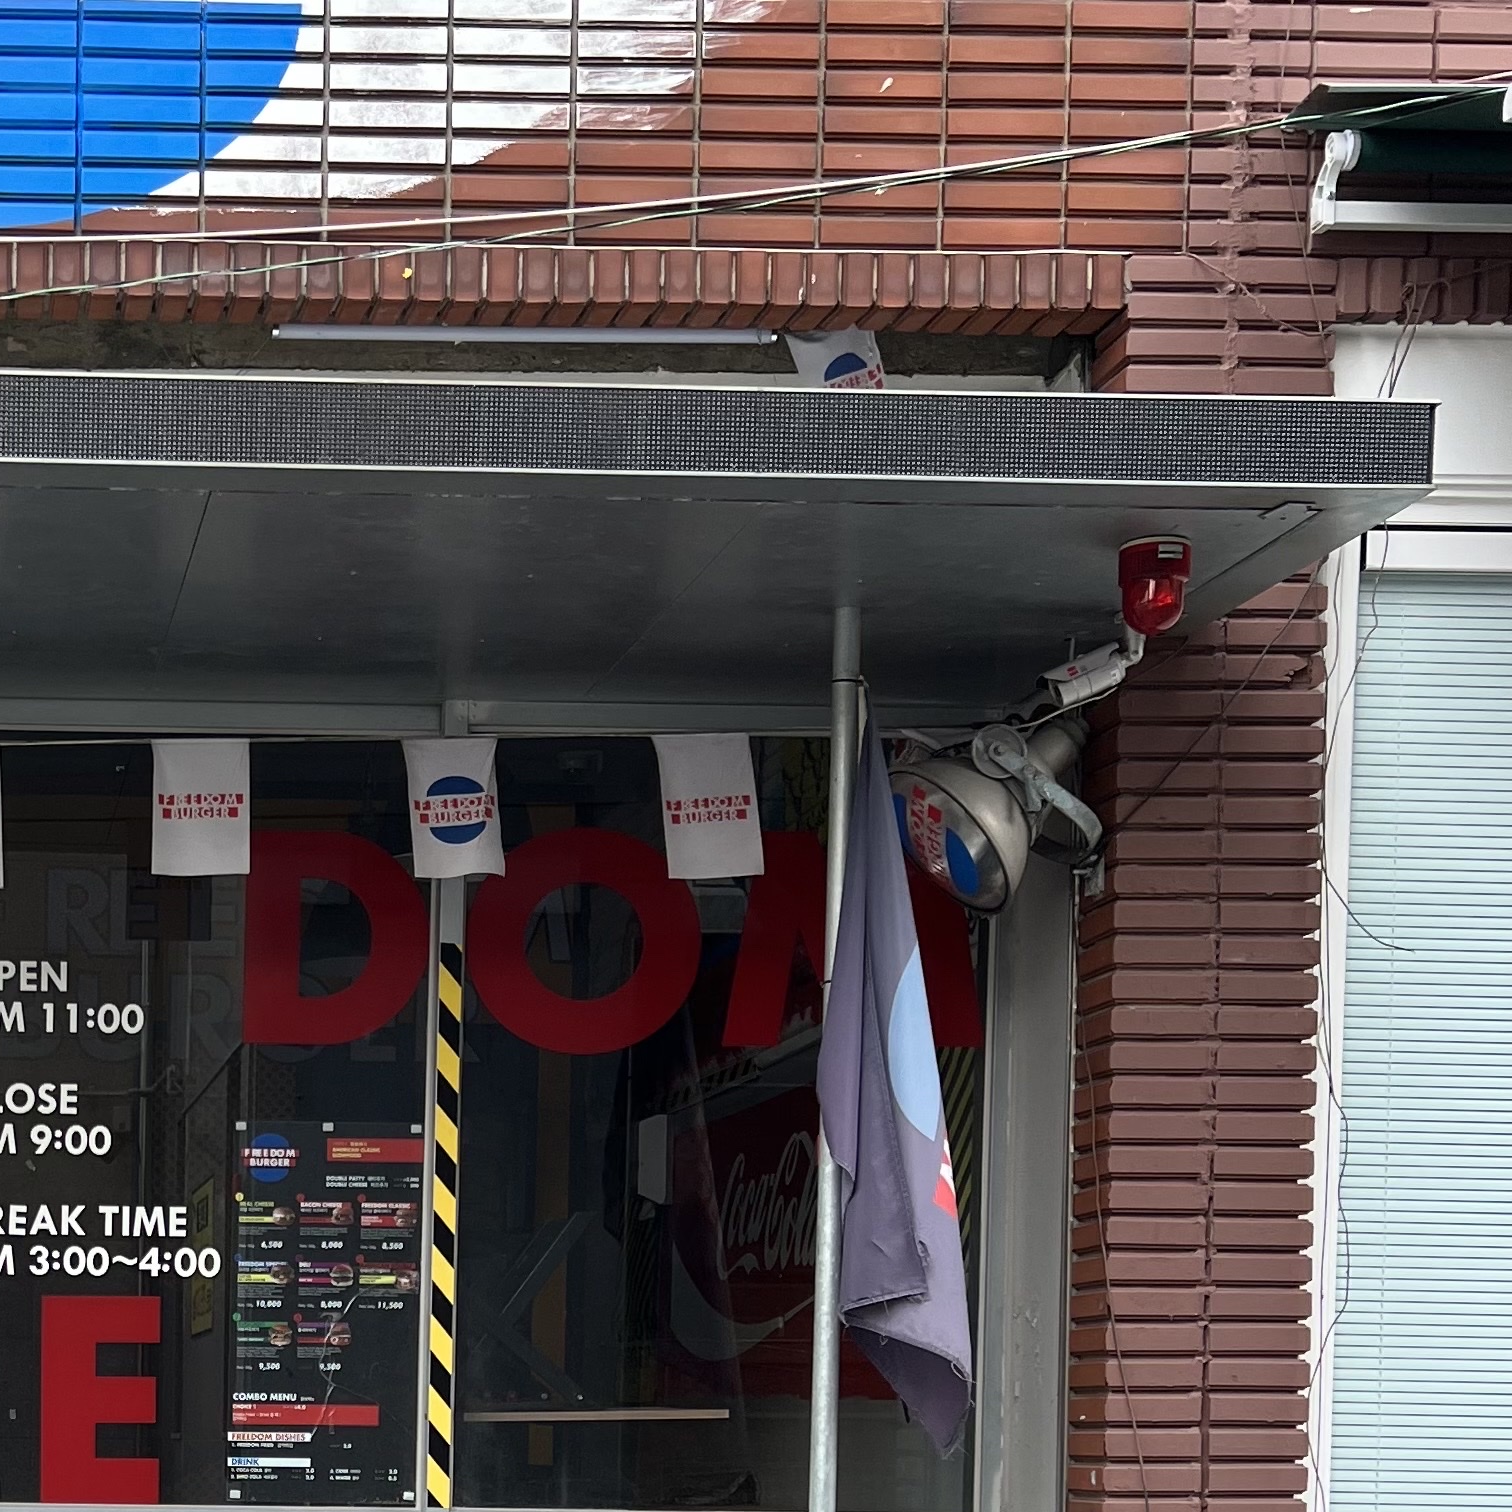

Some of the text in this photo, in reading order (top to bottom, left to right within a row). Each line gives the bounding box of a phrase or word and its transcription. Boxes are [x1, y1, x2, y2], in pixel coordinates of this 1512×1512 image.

[163, 793, 236, 806] FREEDOM
[419, 795, 492, 811] FREEDOM
[671, 795, 743, 811] FREEDOM
[170, 807, 230, 820] BURGER
[428, 807, 487, 824] BURGER
[679, 809, 738, 824] BURGER
[43, 1003, 144, 1034] 11:00
[30, 1124, 112, 1155] 9:00
[244, 1148, 296, 1158] FREEDOM
[249, 1158, 290, 1167] BURGER
[99, 1206, 187, 1237] TIME
[29, 1245, 221, 1277] 3:00~4:00
[233, 1392, 267, 1401] COMBO
[269, 1392, 297, 1401] MENU
[231, 1433, 306, 1441] FREEDOM DISHES
